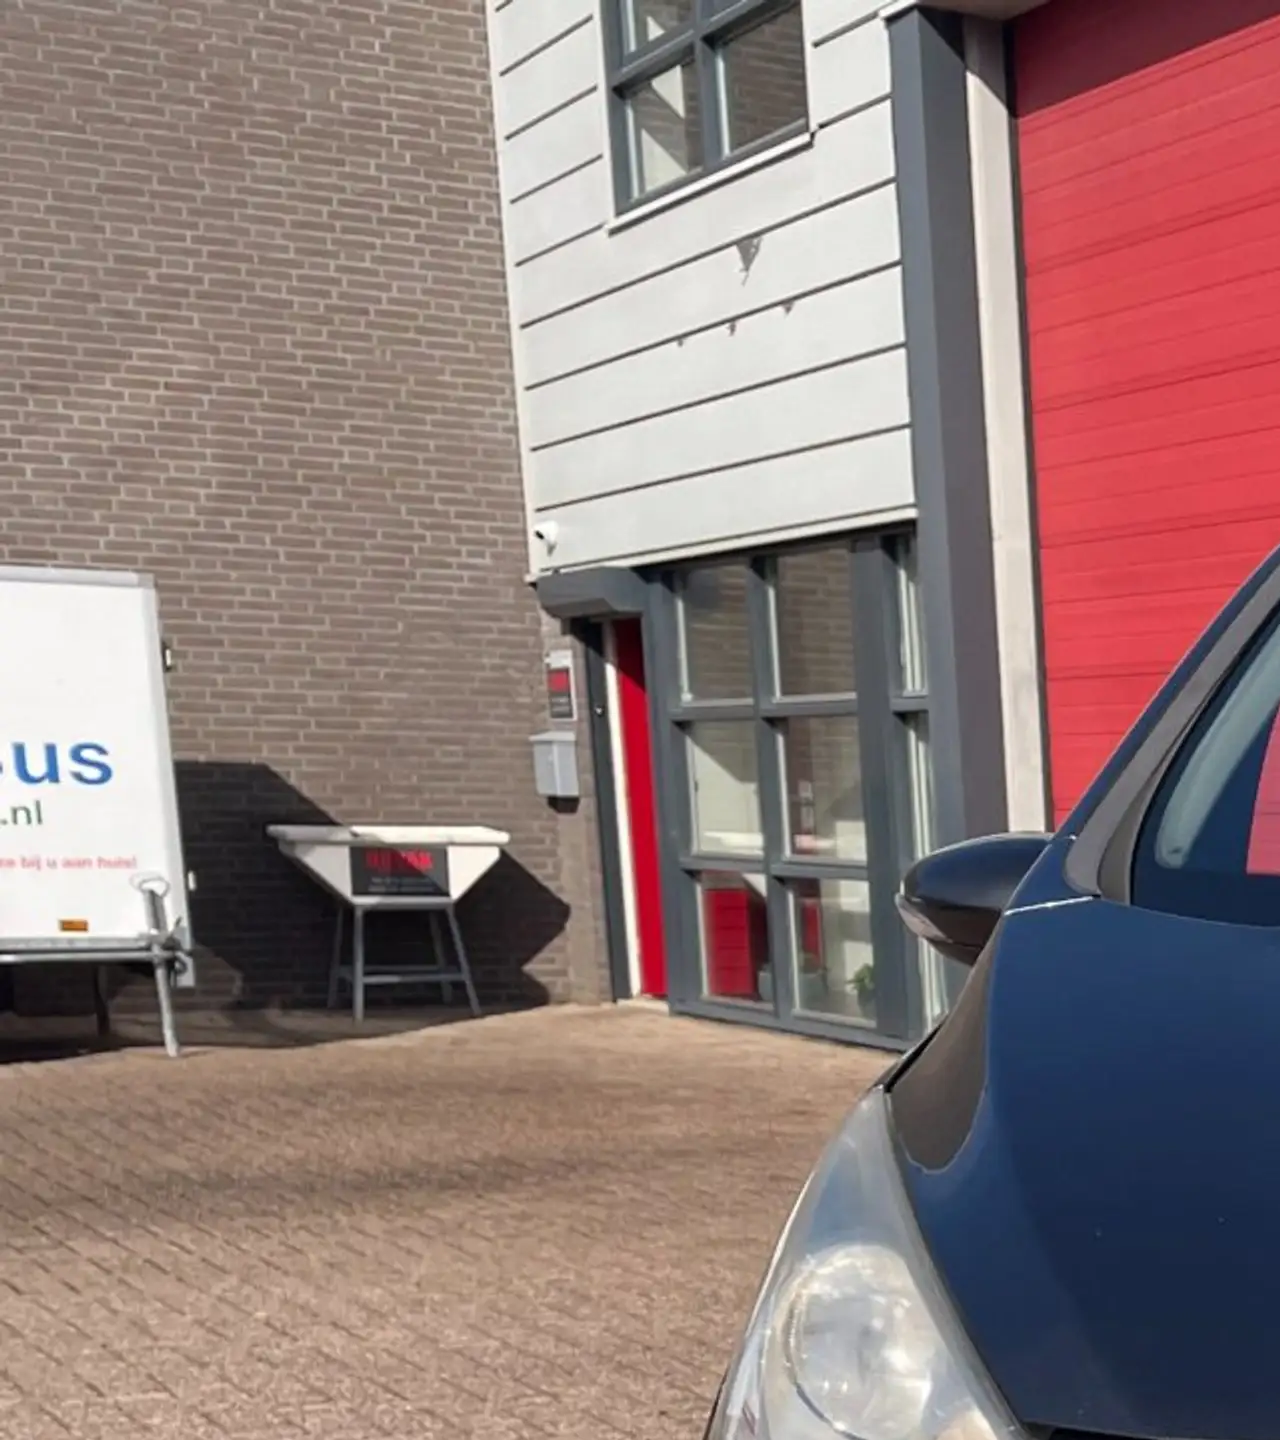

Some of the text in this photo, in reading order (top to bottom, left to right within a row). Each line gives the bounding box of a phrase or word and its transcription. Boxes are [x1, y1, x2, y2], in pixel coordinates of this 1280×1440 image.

[0, 741, 114, 786] us
[21, 855, 42, 871] bij
[46, 857, 57, 869] u
[62, 857, 93, 869] aan
